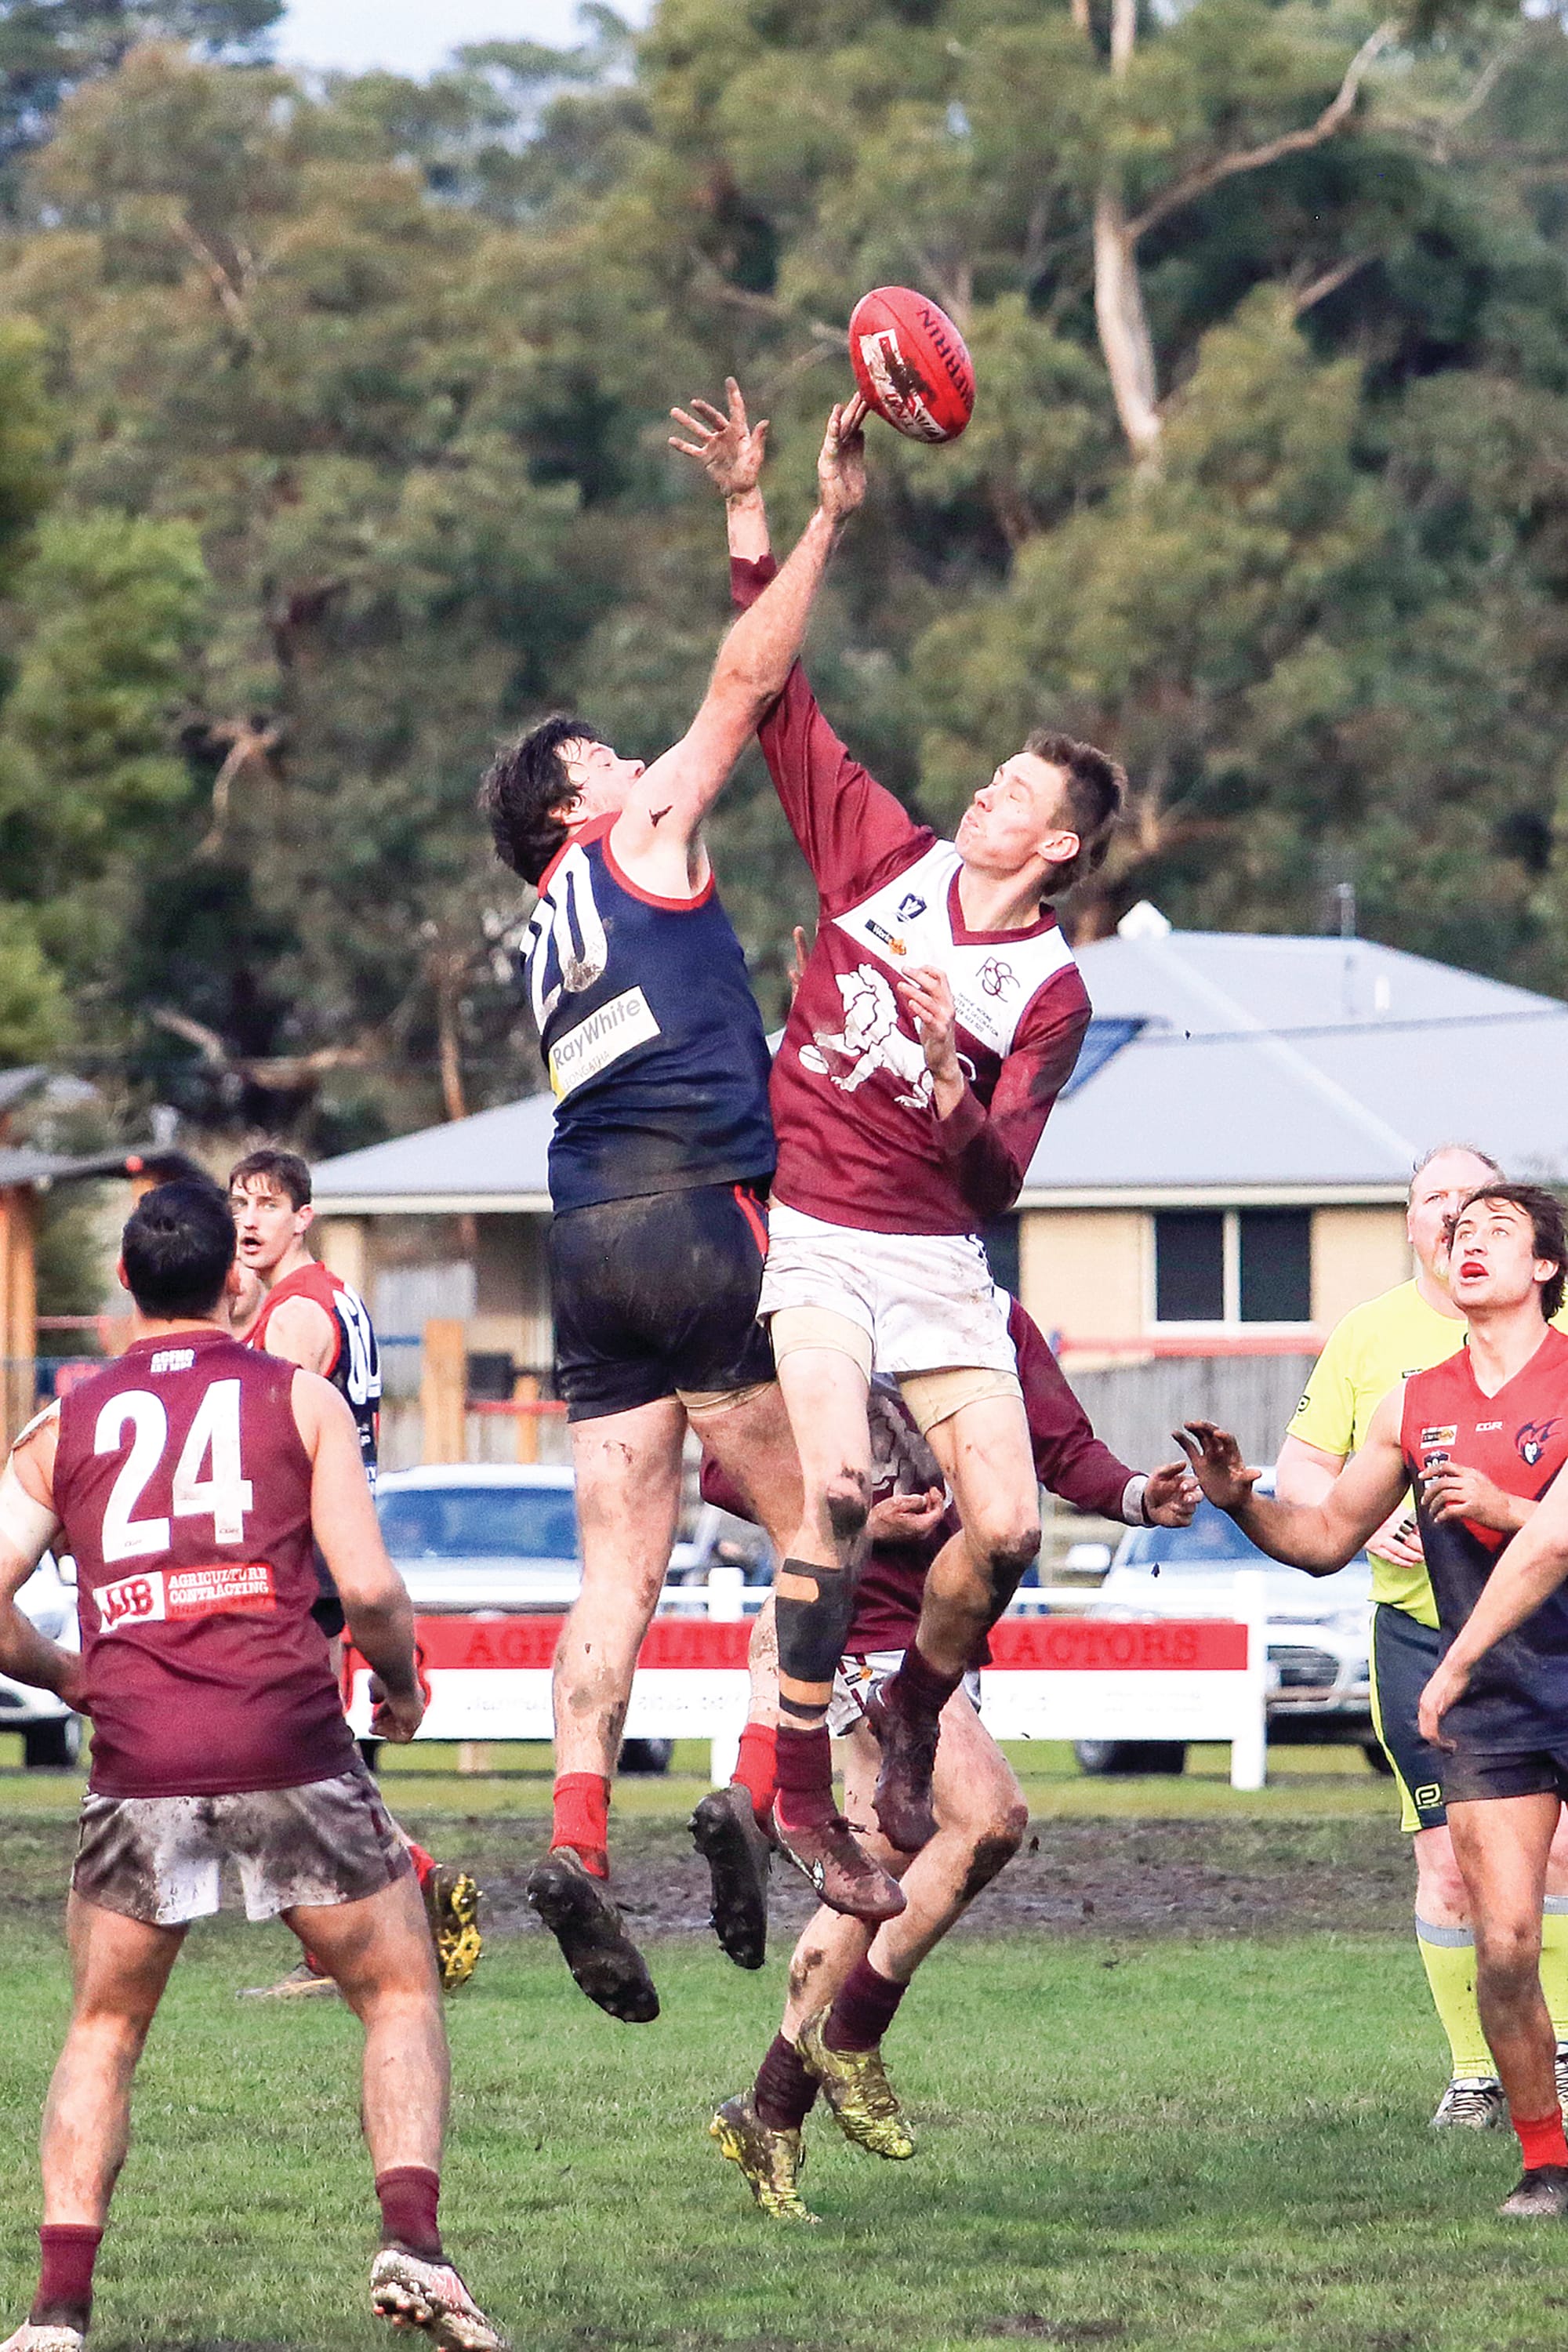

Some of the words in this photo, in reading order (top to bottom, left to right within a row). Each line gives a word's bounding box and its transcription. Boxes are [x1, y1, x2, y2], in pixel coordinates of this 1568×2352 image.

[93, 1377, 253, 1564] 24
[168, 1566, 267, 1589] AGRICULTURE
[169, 1581, 269, 1604] CONTRACTING
